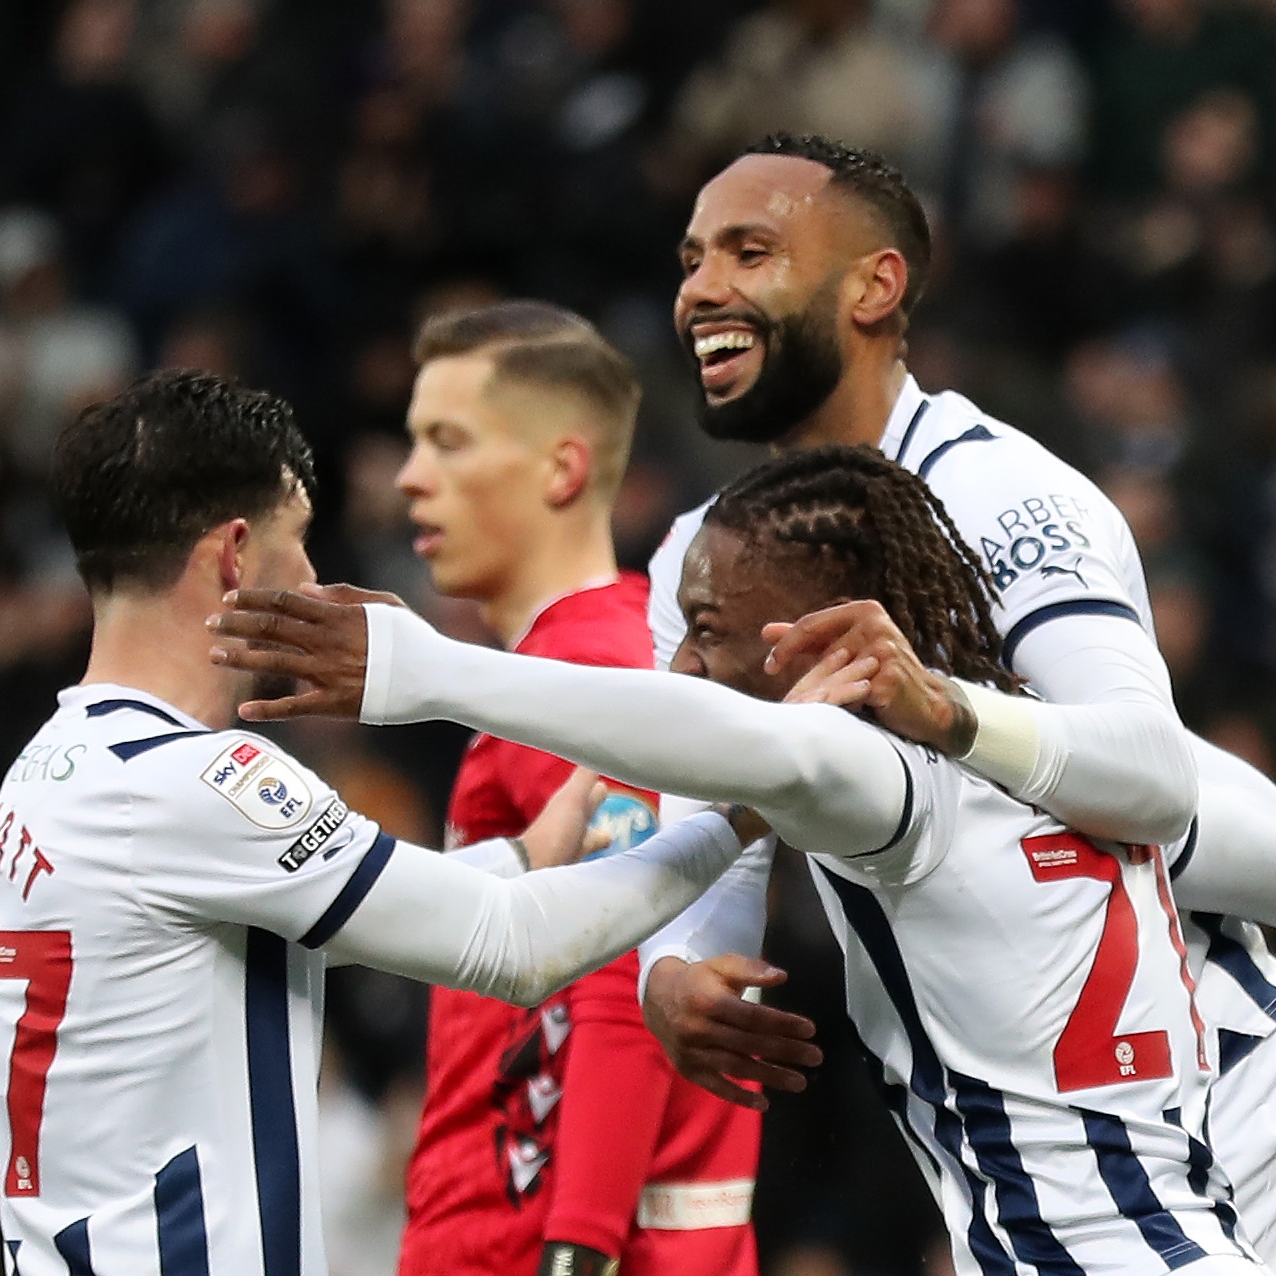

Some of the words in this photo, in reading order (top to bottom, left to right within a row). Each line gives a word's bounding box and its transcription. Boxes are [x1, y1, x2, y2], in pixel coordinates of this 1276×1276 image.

[992, 520, 1091, 592] BOSS
[213, 761, 237, 785] sky
[280, 797, 303, 818] EFL
